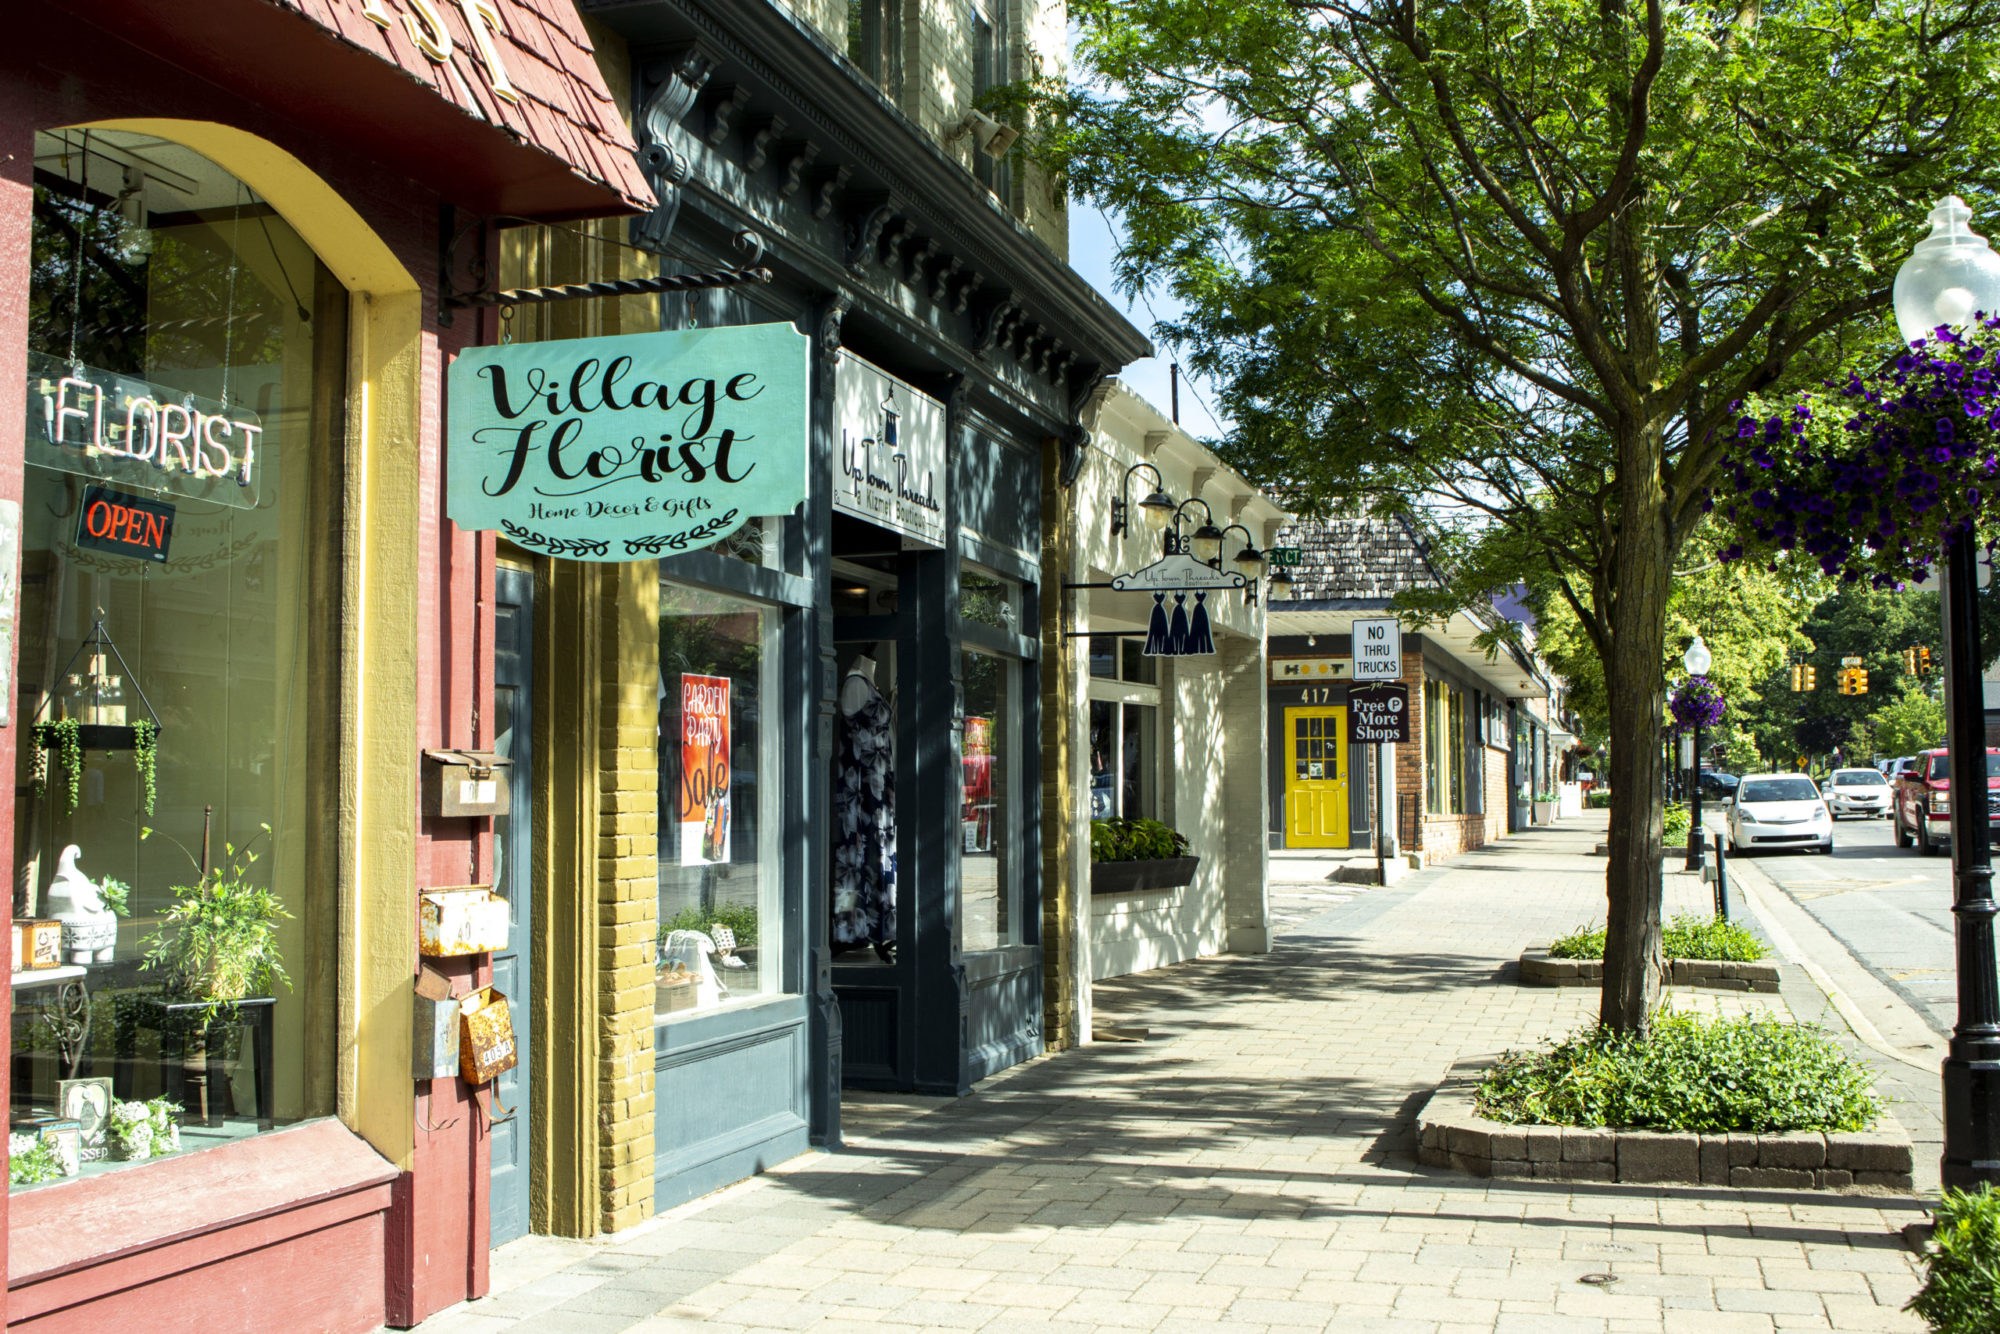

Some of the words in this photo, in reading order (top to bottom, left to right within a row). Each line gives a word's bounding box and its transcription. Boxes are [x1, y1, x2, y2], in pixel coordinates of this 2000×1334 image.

[476, 355, 766, 441] Village
[54, 376, 263, 487] FLORIST
[471, 417, 756, 497] Florist
[528, 501, 580, 520] Home
[644, 497, 659, 512] &
[662, 496, 712, 519] Gifts
[86, 500, 169, 550] OPEN
[1286, 550, 1300, 563] CT
[1368, 626, 1384, 639] NO
[1364, 645, 1390, 656] THRU
[1357, 661, 1397, 673] TRUCKS
[683, 682, 727, 718] GARDEN
[1301, 688, 1330, 703] 417
[1353, 699, 1386, 712] Free
[1358, 712, 1399, 725] More
[687, 716, 723, 754] PARTY
[1356, 726, 1400, 742] Shops
